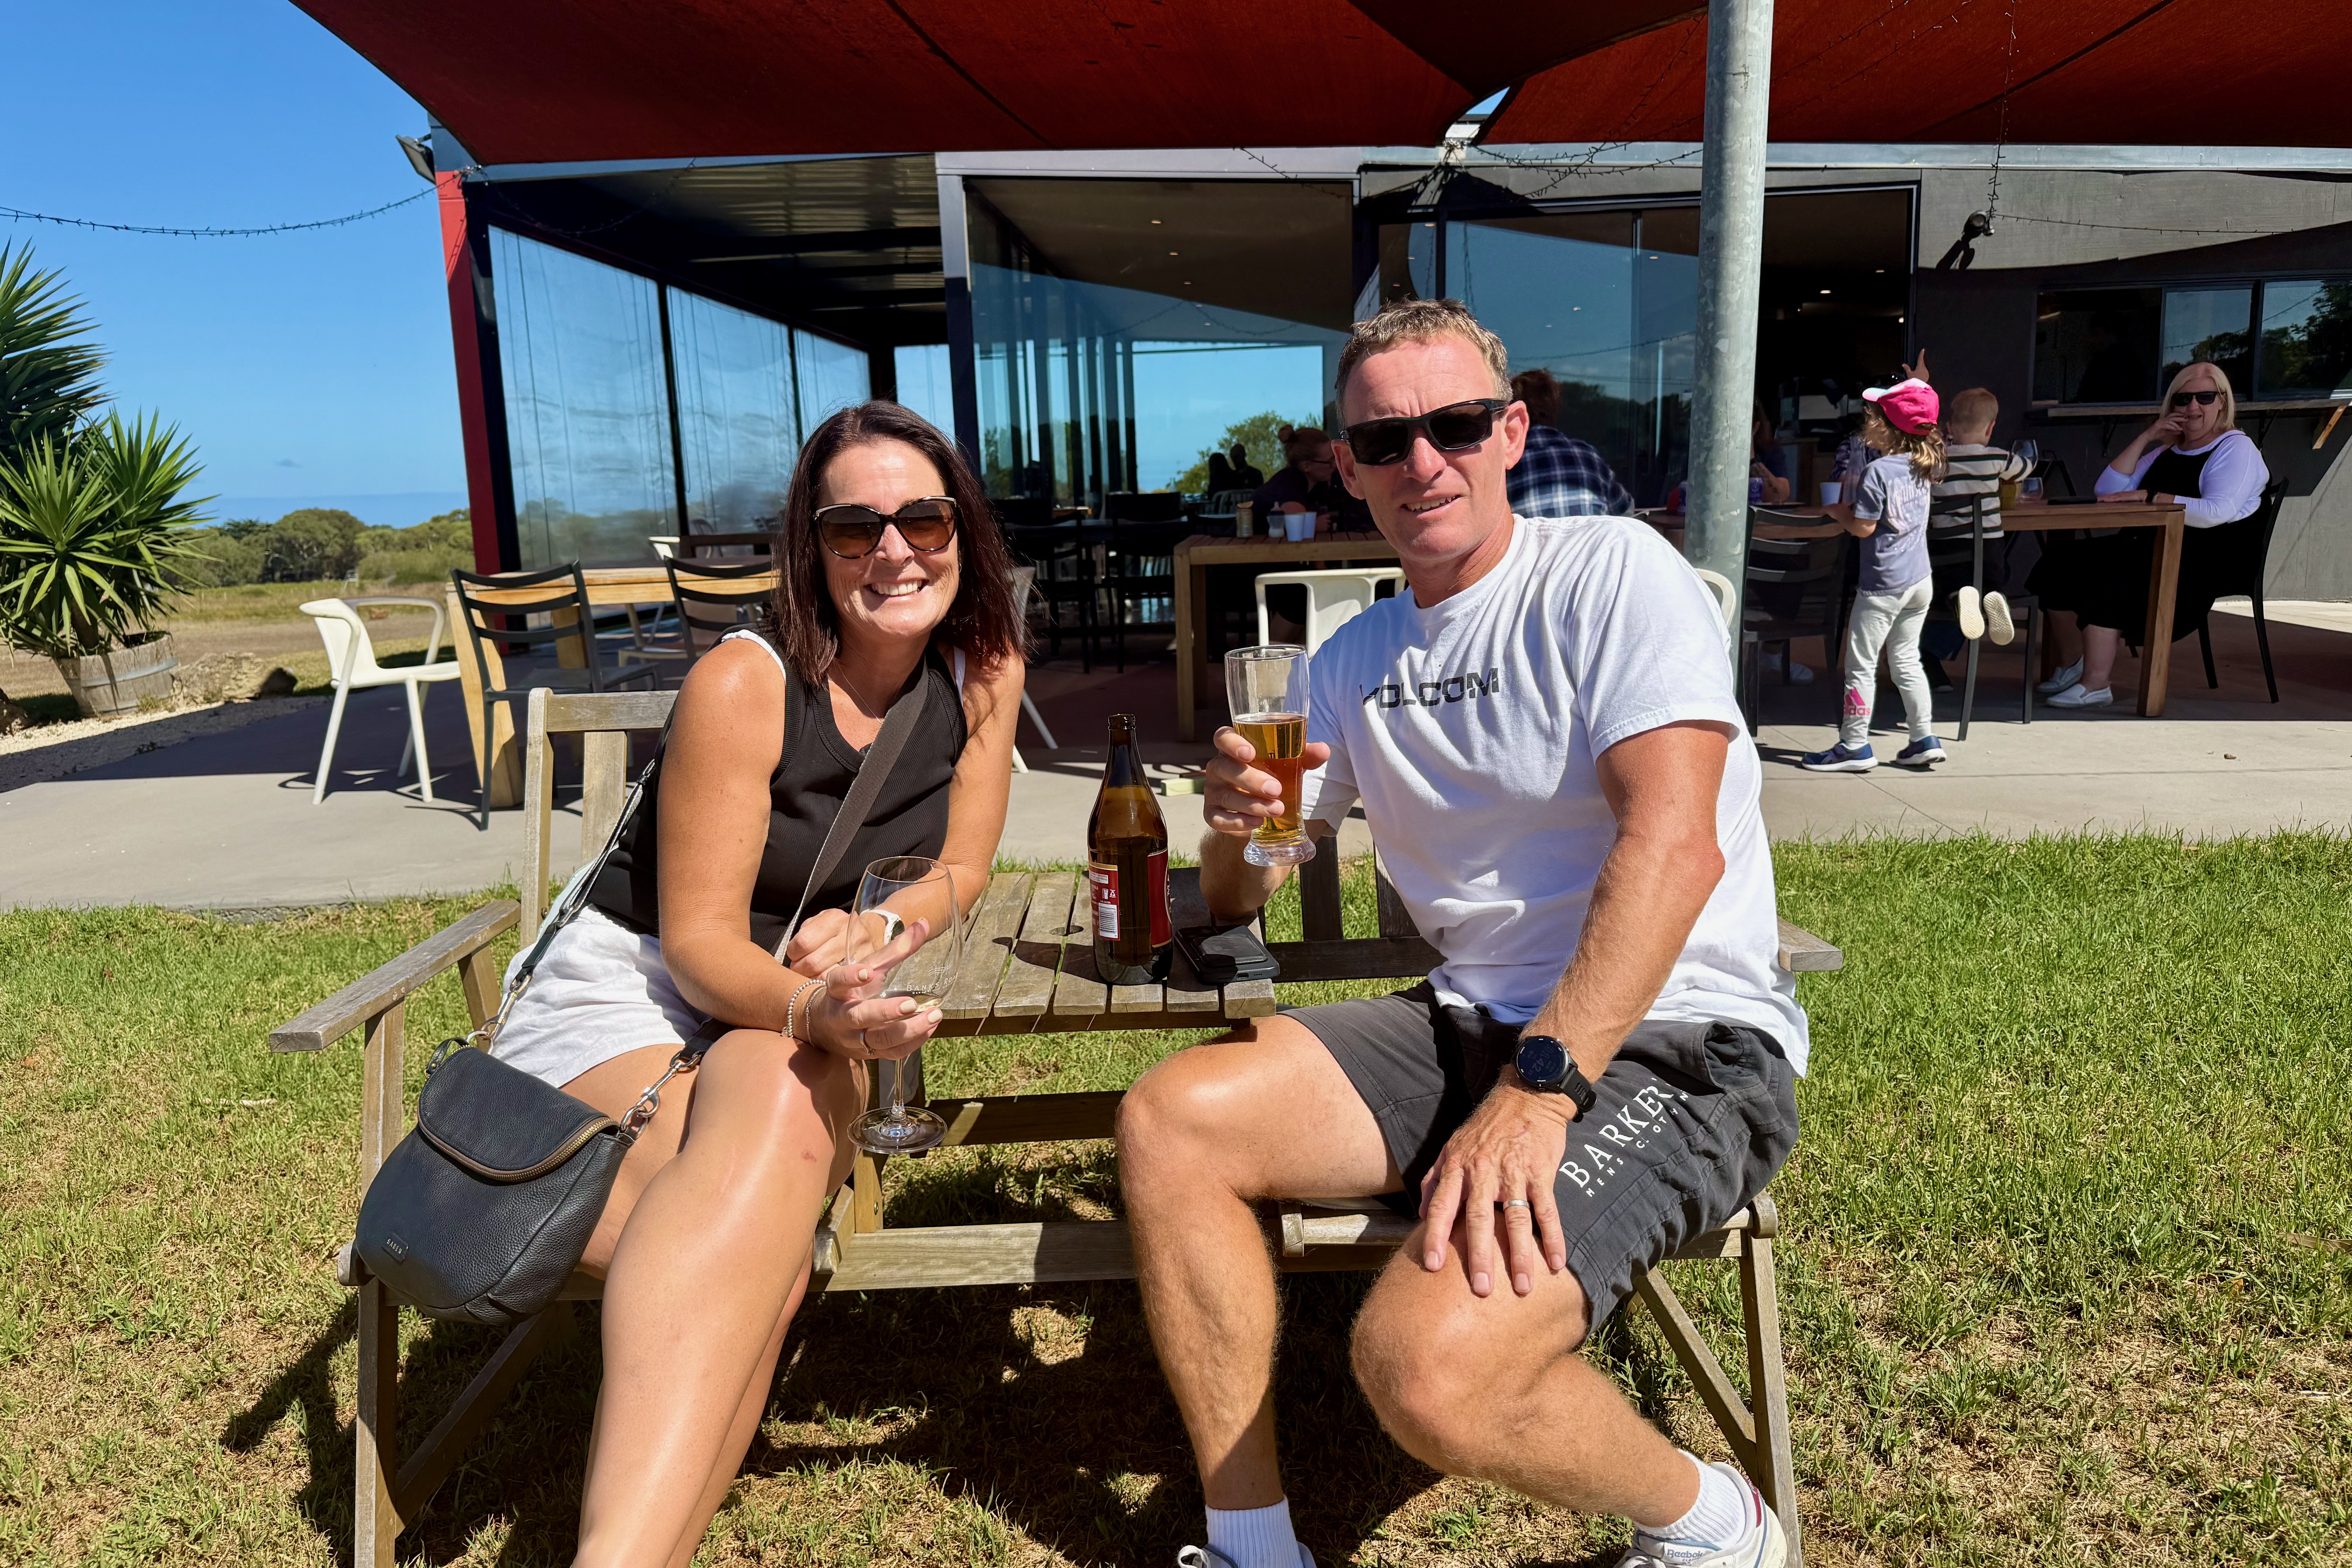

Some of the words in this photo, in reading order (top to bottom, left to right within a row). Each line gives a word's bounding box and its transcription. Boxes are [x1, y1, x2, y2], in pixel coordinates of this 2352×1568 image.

[907, 982, 940, 992] BANKS
[1586, 1157, 1624, 1197] MENS
[386, 1239, 403, 1254] SABEN
[1667, 1549, 1703, 1558] Reebok
